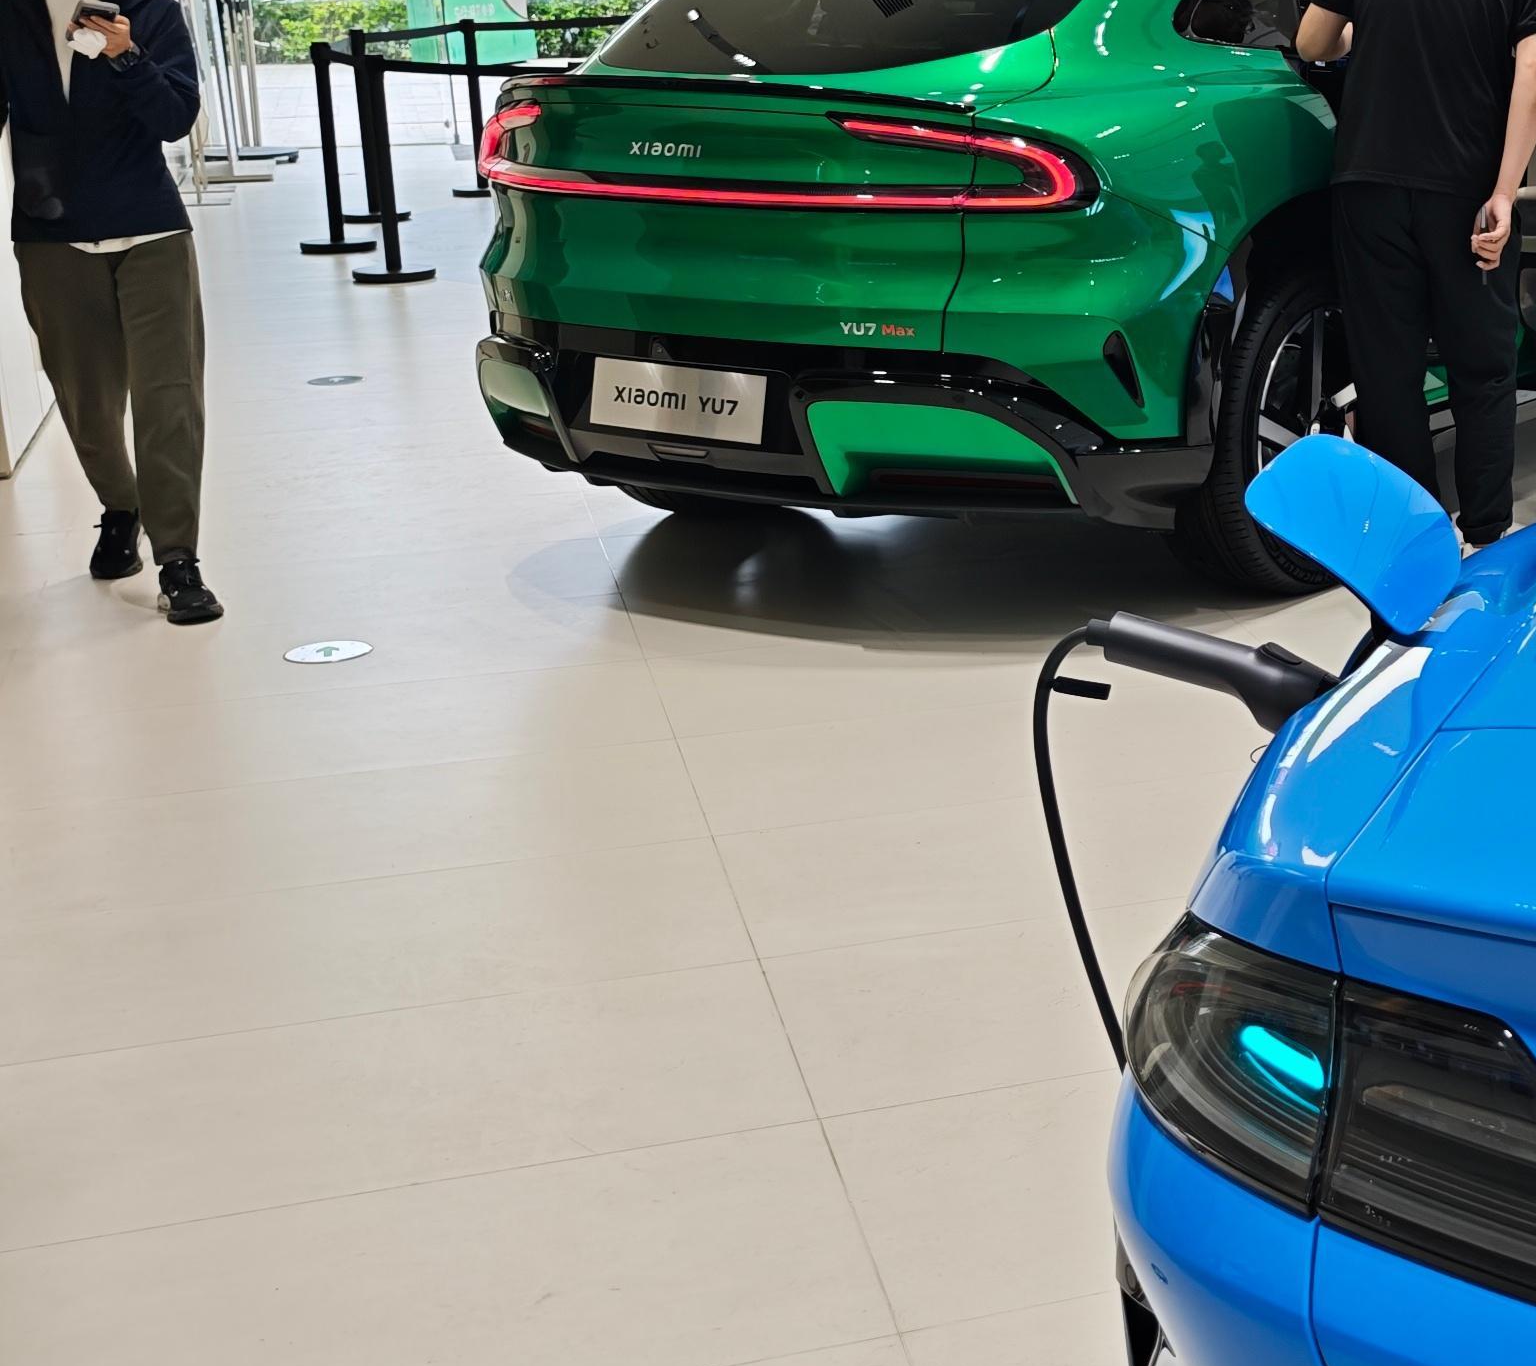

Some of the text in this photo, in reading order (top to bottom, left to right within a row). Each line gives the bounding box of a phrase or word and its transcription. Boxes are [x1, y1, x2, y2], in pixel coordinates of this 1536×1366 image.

[840, 322, 915, 337] YU7 Max
[698, 396, 739, 417] YU7
